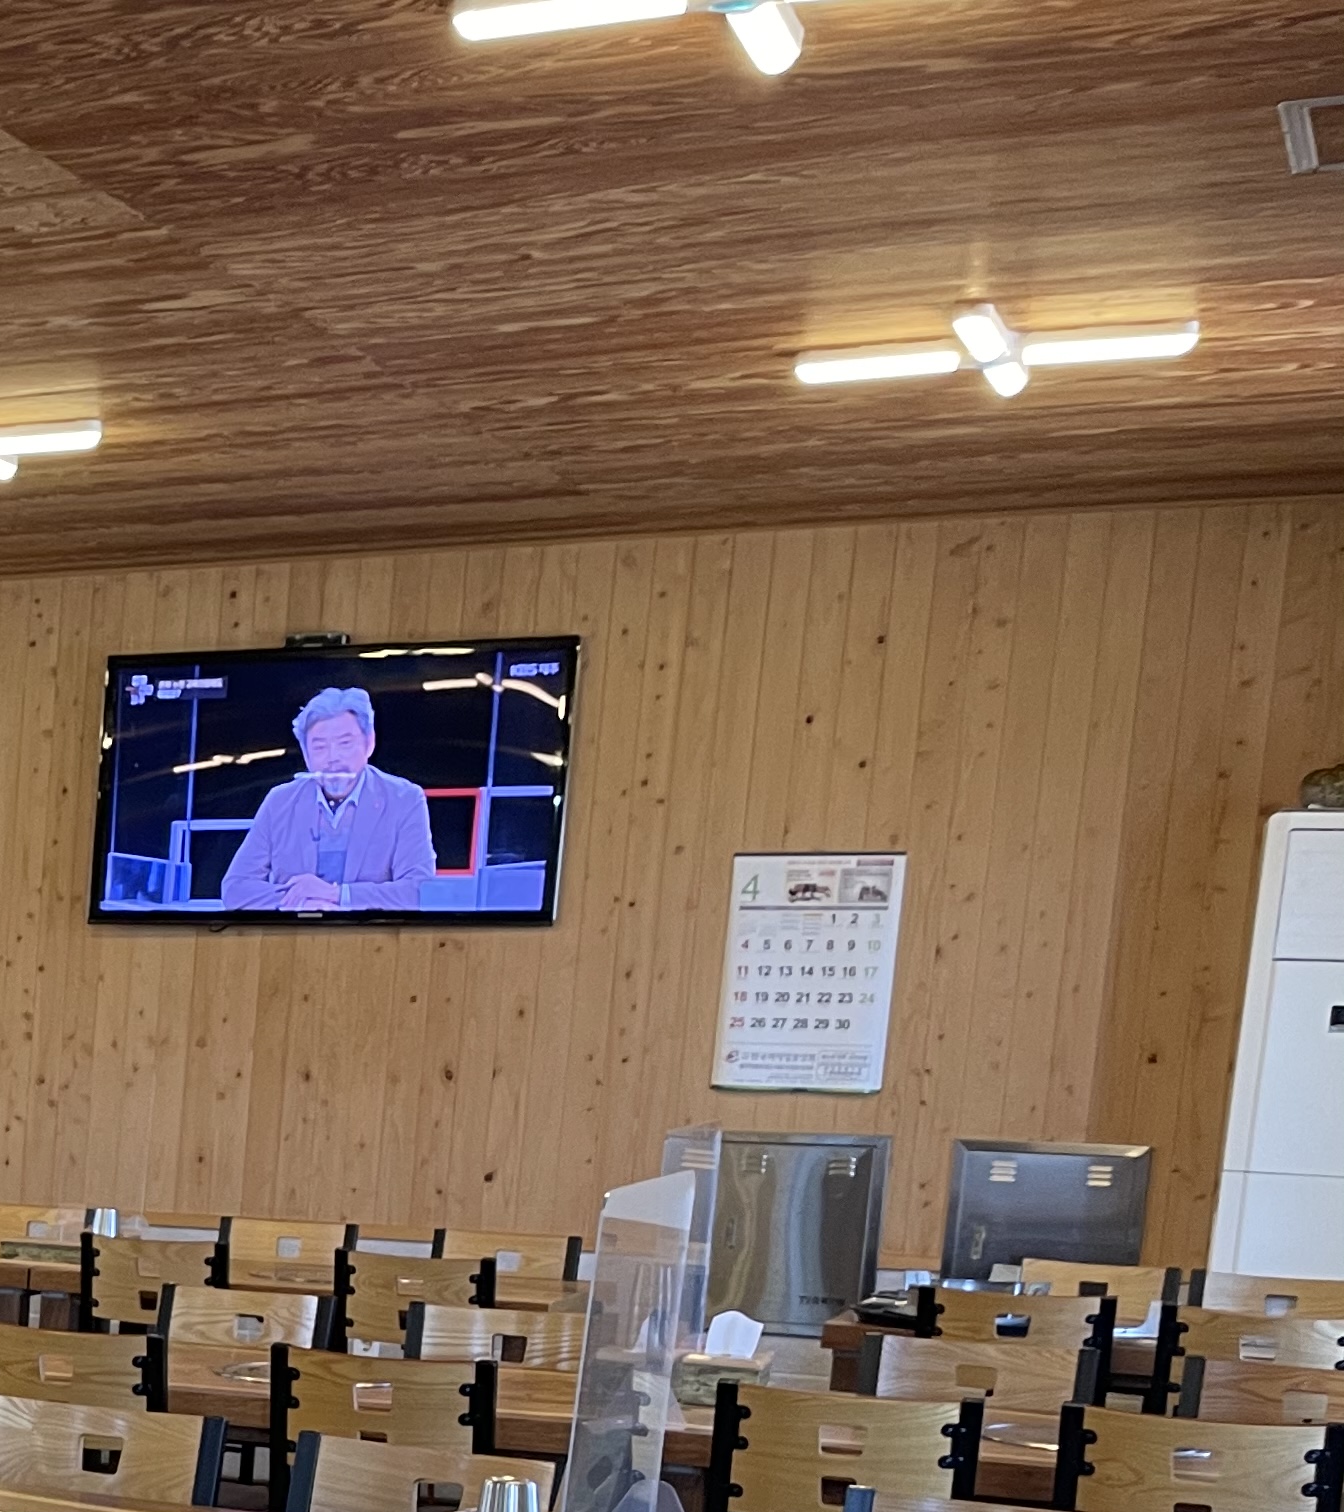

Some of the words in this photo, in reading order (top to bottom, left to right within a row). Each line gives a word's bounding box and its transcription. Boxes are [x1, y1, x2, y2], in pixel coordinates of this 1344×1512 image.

[741, 874, 760, 901] 4
[832, 914, 836, 923] 1
[851, 914, 858, 924] 2
[874, 914, 880, 924] 3
[741, 940, 749, 949] 4
[763, 940, 770, 949] 5
[784, 940, 792, 950] 6
[806, 940, 813, 950] 7
[827, 940, 834, 950] 8
[848, 941, 855, 950] 9
[868, 941, 880, 950] 10
[738, 966, 748, 975] 11
[758, 966, 771, 976] 12
[779, 966, 792, 976] 13
[801, 966, 813, 976] 14
[822, 966, 835, 976] 15
[843, 967, 856, 977] 16
[865, 967, 878, 977] 17
[734, 992, 747, 1001] 18
[755, 992, 768, 1002] 19
[776, 992, 789, 1002] 20
[796, 992, 809, 1002] 21
[817, 992, 832, 1003] 22
[838, 993, 853, 1003] 23
[859, 993, 874, 1003] 24
[730, 1017, 744, 1027] 25
[750, 1018, 765, 1027] 26
[772, 1018, 786, 1028] 27
[793, 1018, 808, 1028] 28
[814, 1018, 829, 1028] 29
[835, 1019, 850, 1029] 30
